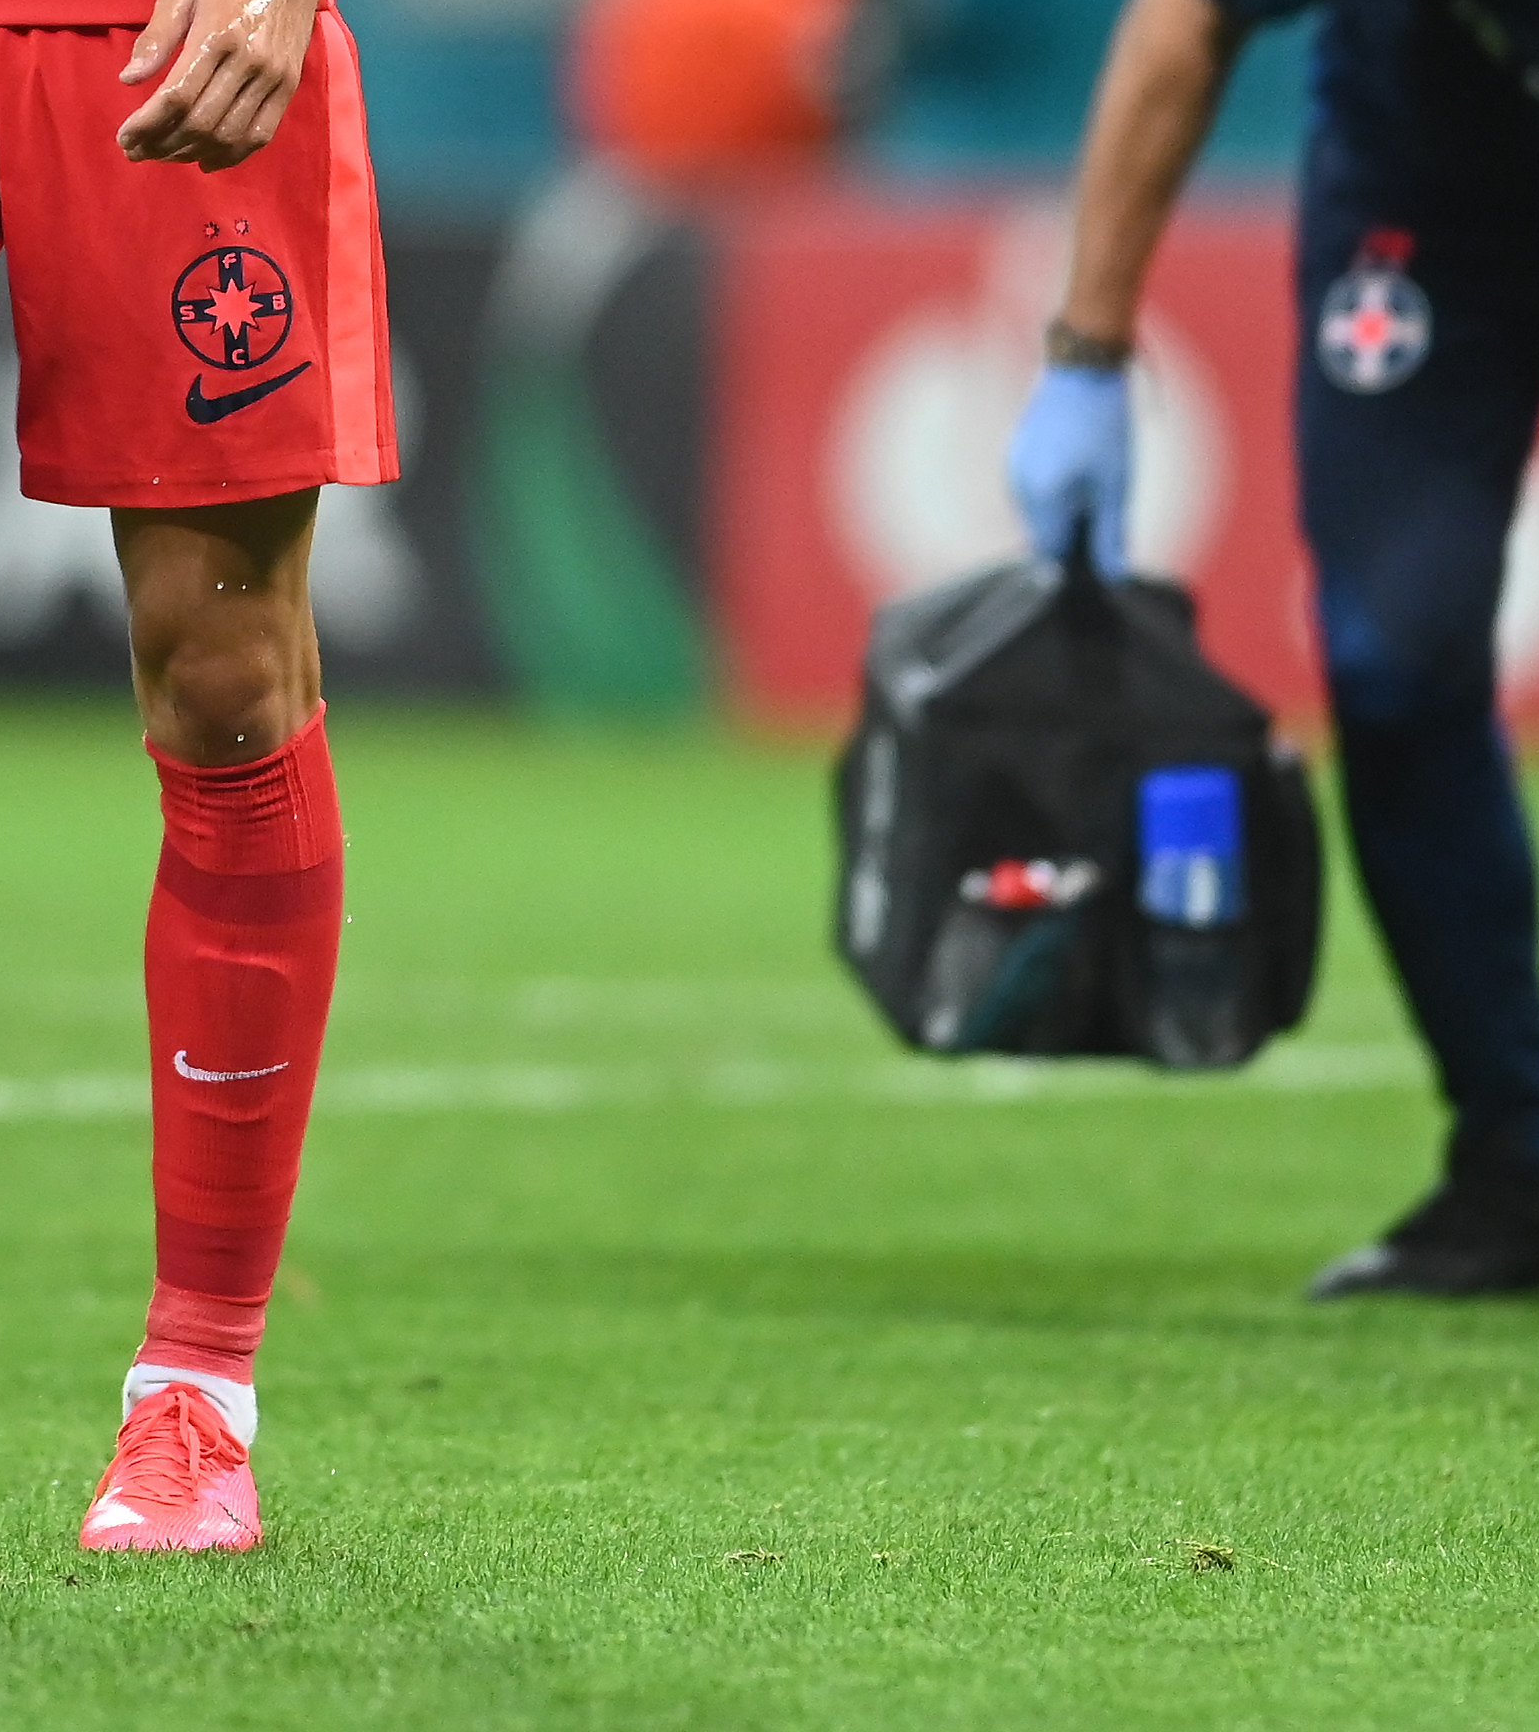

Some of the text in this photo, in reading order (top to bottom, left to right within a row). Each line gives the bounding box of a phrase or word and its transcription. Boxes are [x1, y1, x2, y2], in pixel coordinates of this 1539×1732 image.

[272, 294, 287, 310] B
[179, 305, 195, 321] S
[231, 348, 246, 365] C
